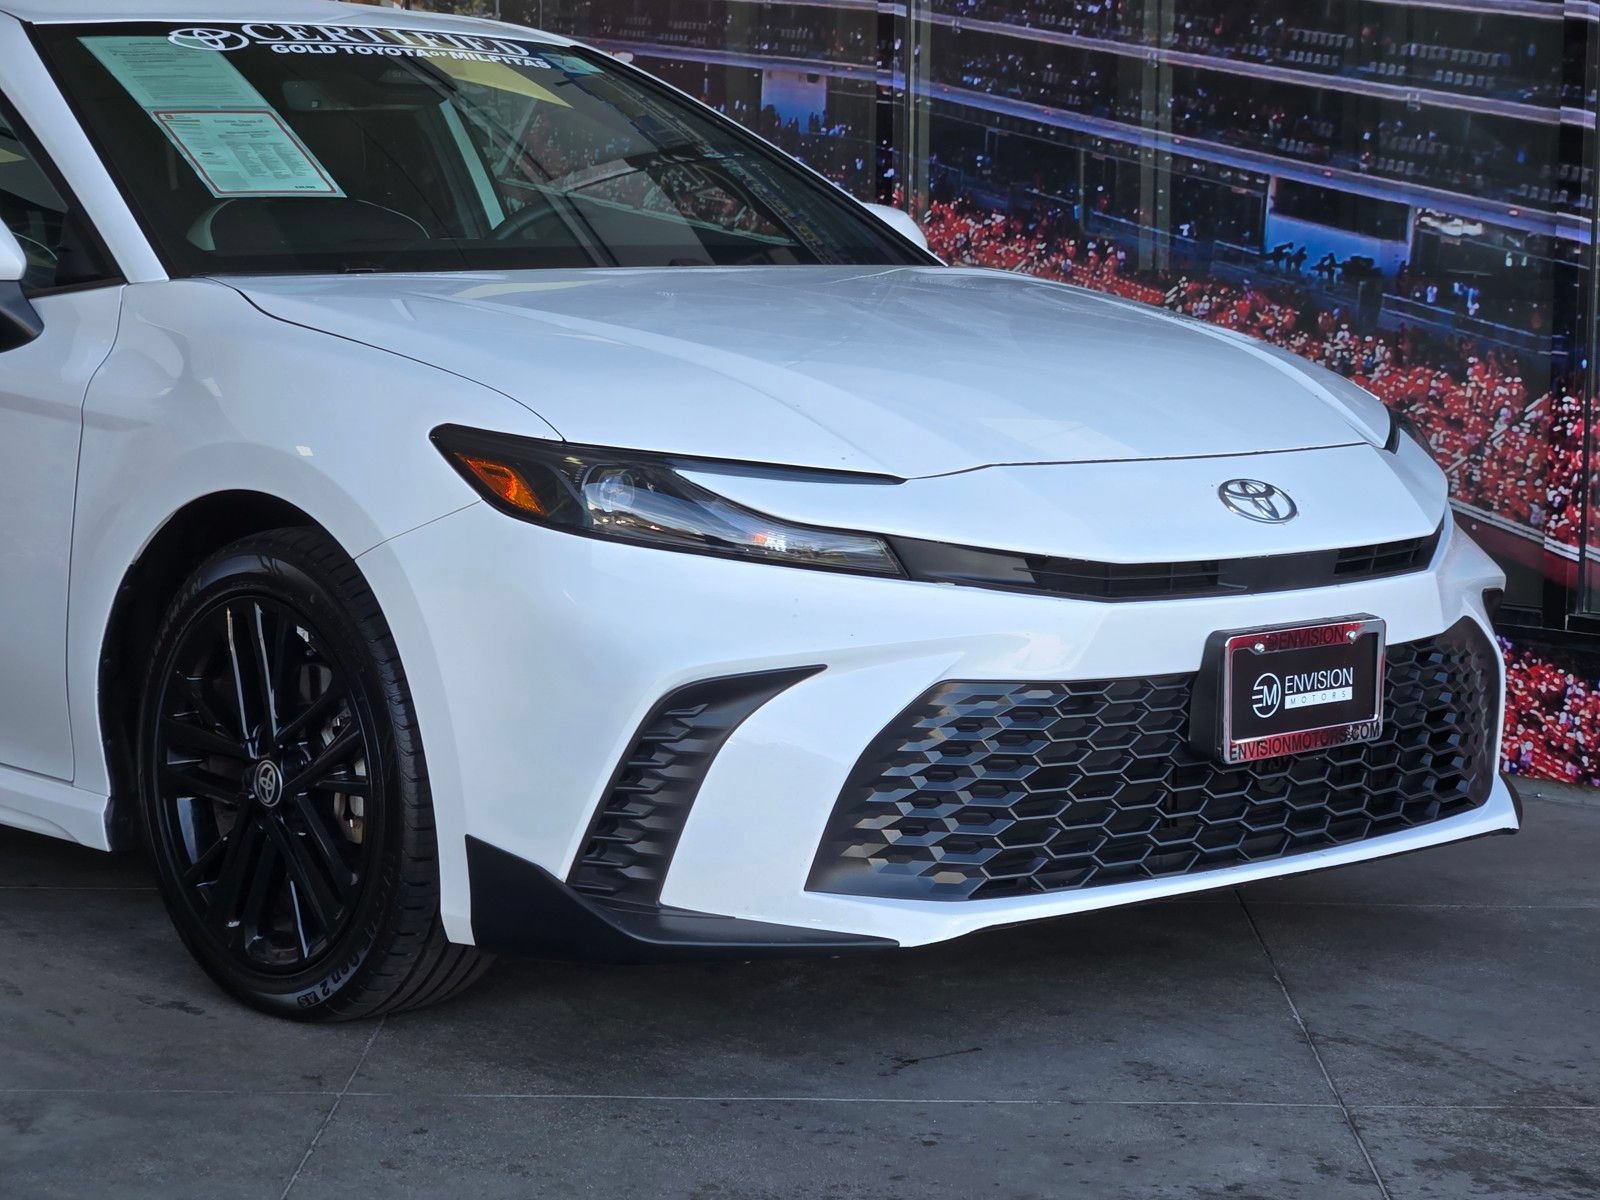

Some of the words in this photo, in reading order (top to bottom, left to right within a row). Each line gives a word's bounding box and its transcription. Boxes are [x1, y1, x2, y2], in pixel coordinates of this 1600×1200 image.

[242, 24, 530, 56] CERTIFIED
[271, 45, 337, 54] GOLD
[345, 45, 432, 58] TOYOTA
[449, 51, 551, 69] MILPITAS
[1279, 626, 1345, 650] ENVISION
[1285, 667, 1353, 694] ENVISION
[1290, 690, 1347, 705] MOTORS
[319, 979, 332, 996] 2
